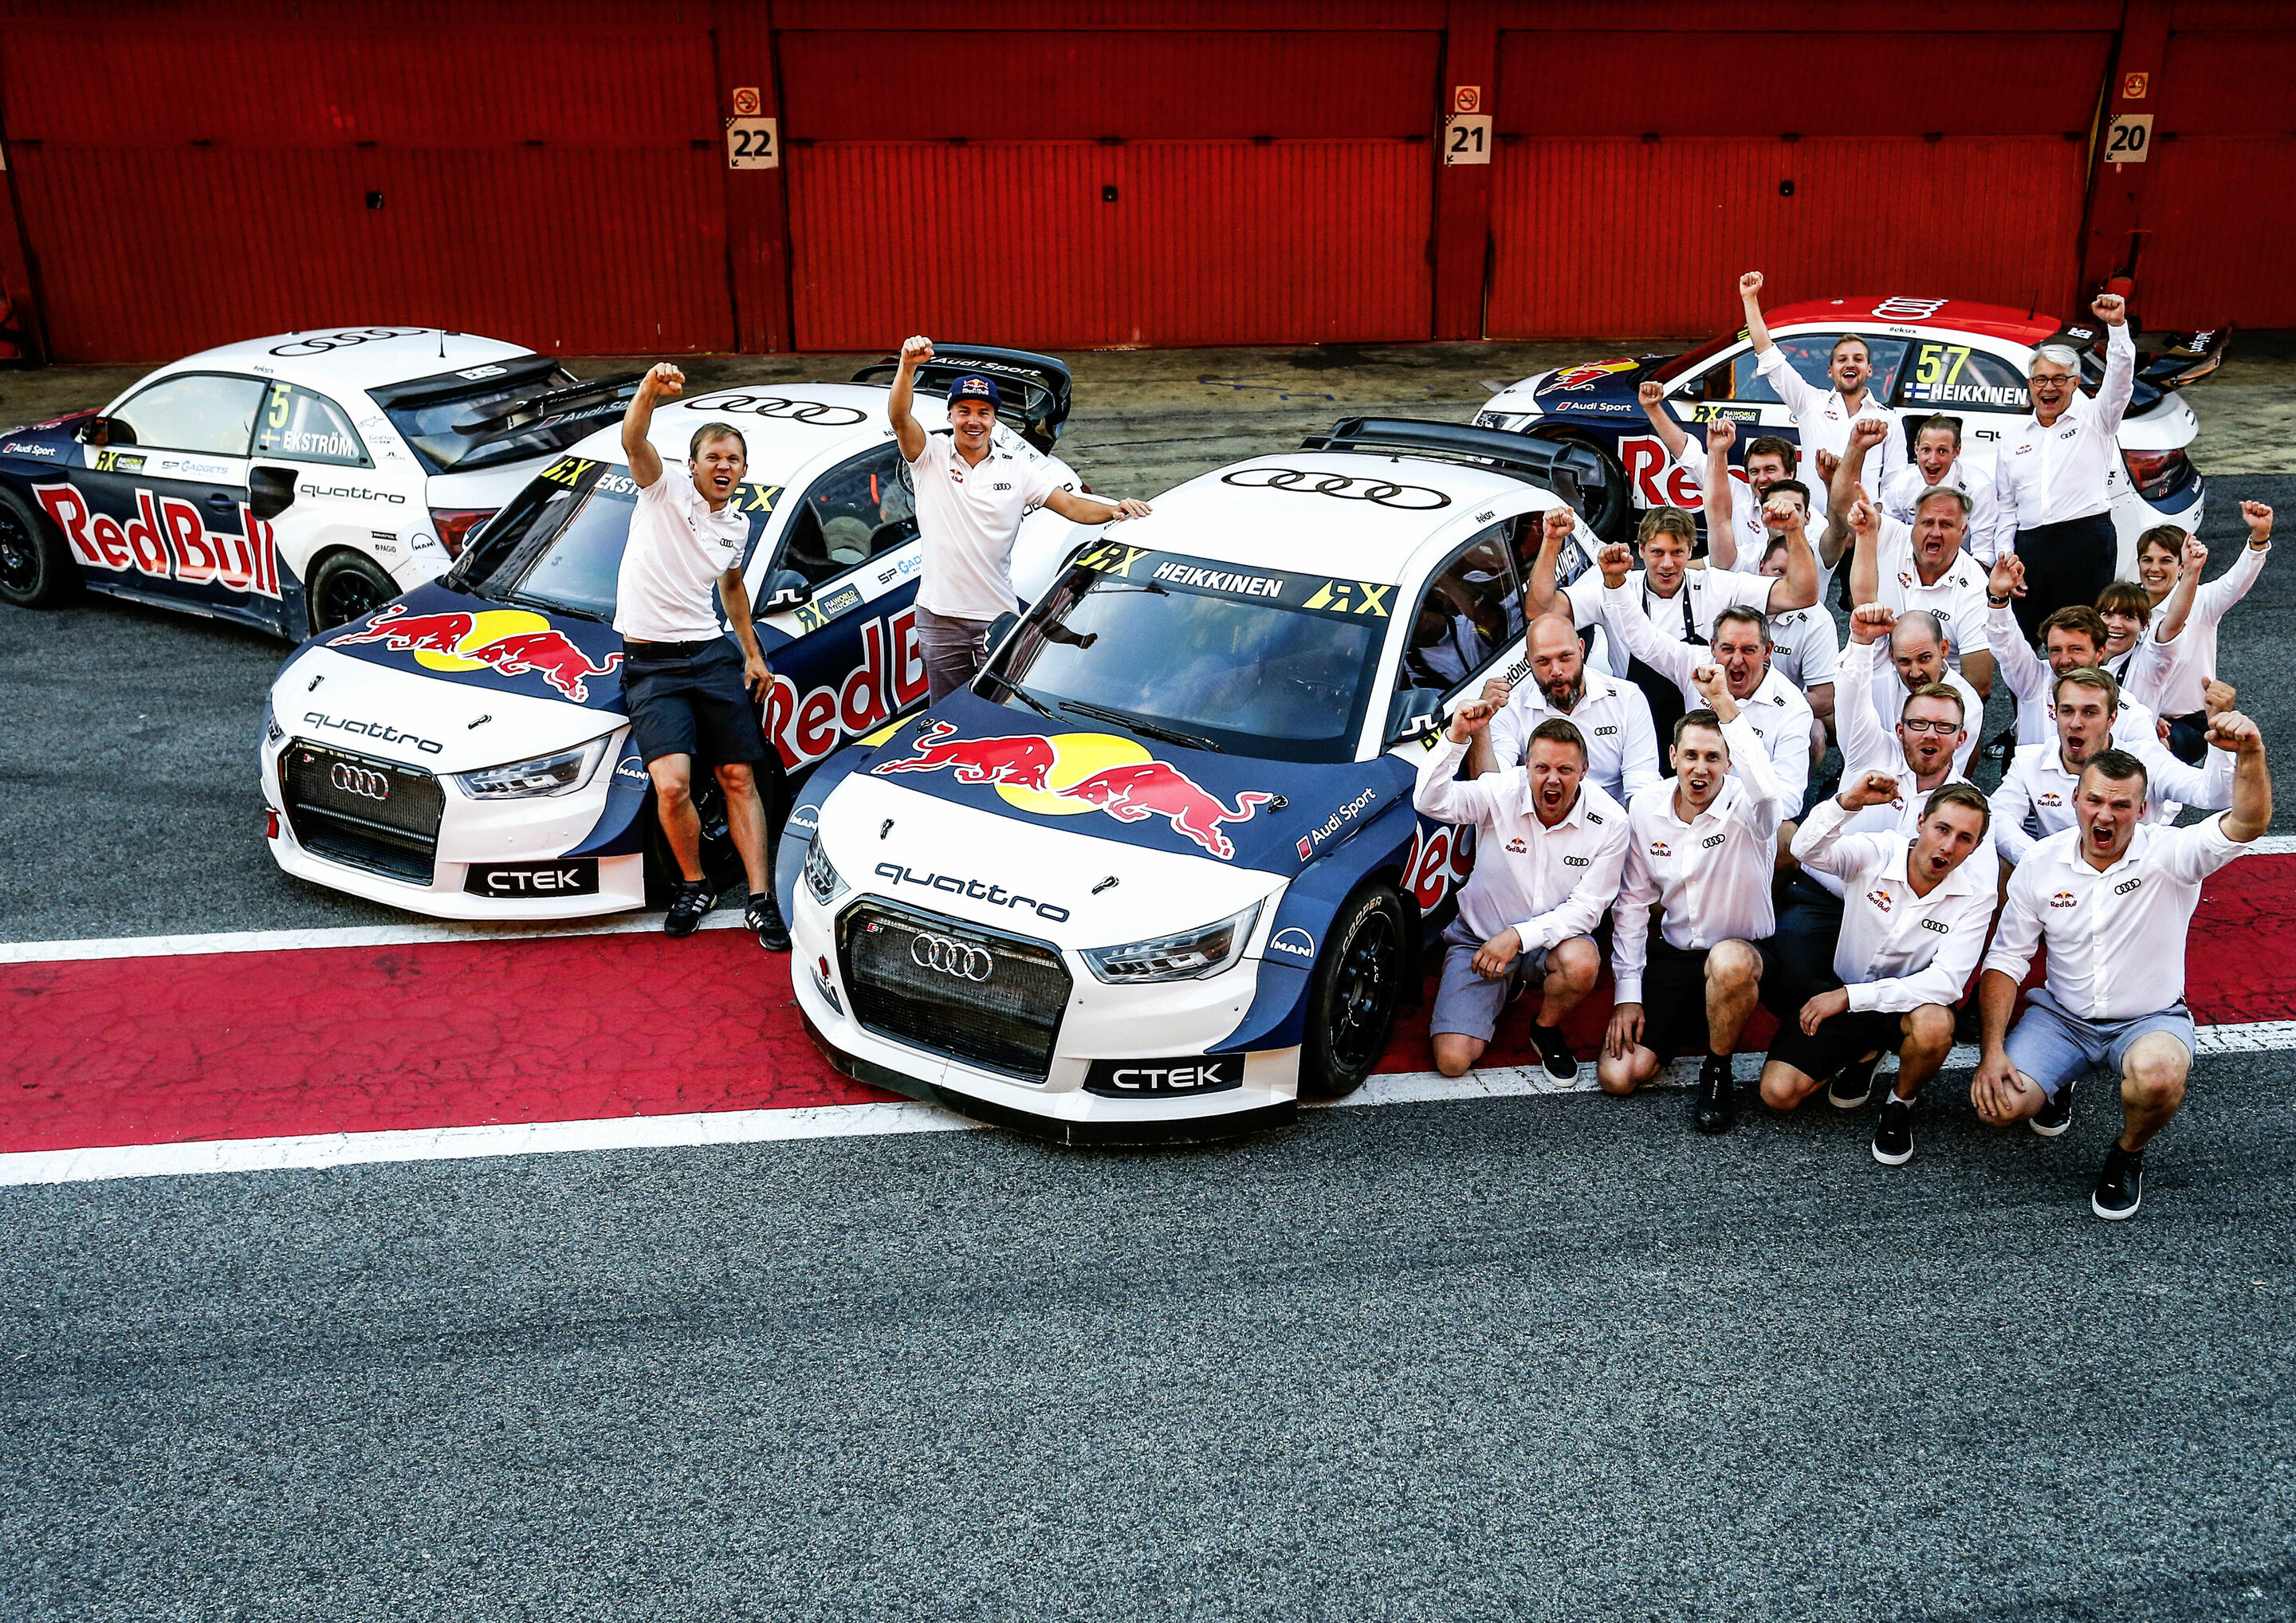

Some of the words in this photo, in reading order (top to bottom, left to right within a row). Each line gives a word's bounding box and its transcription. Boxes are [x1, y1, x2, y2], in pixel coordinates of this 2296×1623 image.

[733, 129, 773, 157] 22
[1451, 126, 1484, 152] 21
[2109, 125, 2145, 151] 20
[932, 356, 979, 367] Audi
[981, 362, 1041, 377] Sport
[1916, 344, 1972, 385] 57
[268, 383, 293, 429] 5
[1571, 401, 1597, 411] Audi
[1599, 403, 1633, 413] Sport
[1929, 383, 2028, 405] HEIKKINEN
[560, 405, 606, 423] Audi
[13, 444, 32, 454] Audi
[33, 444, 57, 457] Sport
[282, 430, 353, 457] EKSTRÖM
[301, 484, 406, 504] quattro
[1151, 560, 1284, 598] HEIKKINEN
[303, 712, 443, 754] quattro
[619, 767, 644, 780] MAN
[1310, 812, 1343, 847] Audi
[1339, 787, 1378, 820] Sport
[487, 868, 581, 890] CTEK
[875, 862, 1070, 923] quattro
[1866, 892, 1879, 905] Red
[1877, 902, 1891, 914] Bull
[1342, 895, 1382, 953] COOPER
[1272, 941, 1311, 957] MAN
[1112, 1063, 1223, 1089] CTEK
